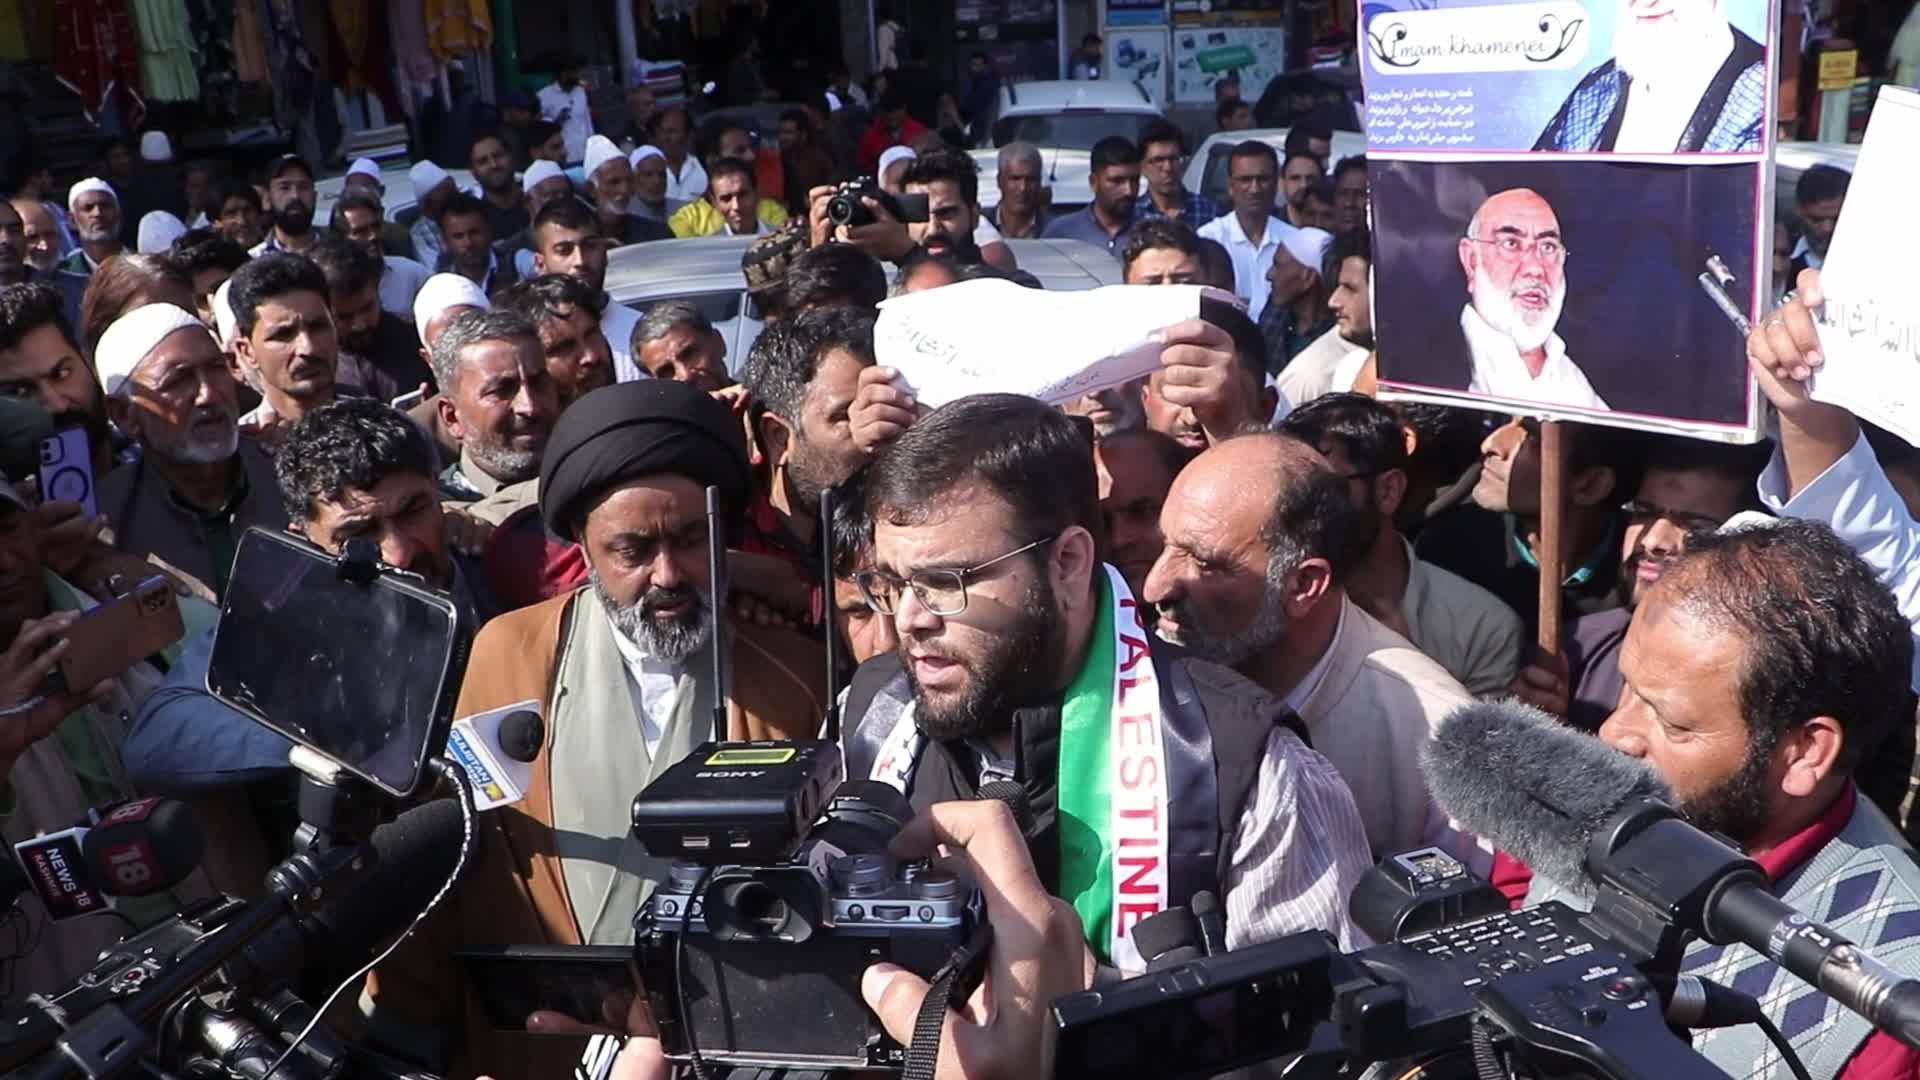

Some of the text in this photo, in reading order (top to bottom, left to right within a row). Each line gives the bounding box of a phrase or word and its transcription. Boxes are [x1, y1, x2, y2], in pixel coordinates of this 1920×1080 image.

[450, 730, 491, 781] GULISTAN
[695, 770, 766, 778] SONY
[1117, 598, 1159, 938] PALESTINE
[46, 848, 91, 906] NEWS 18
[109, 845, 152, 886] 18
